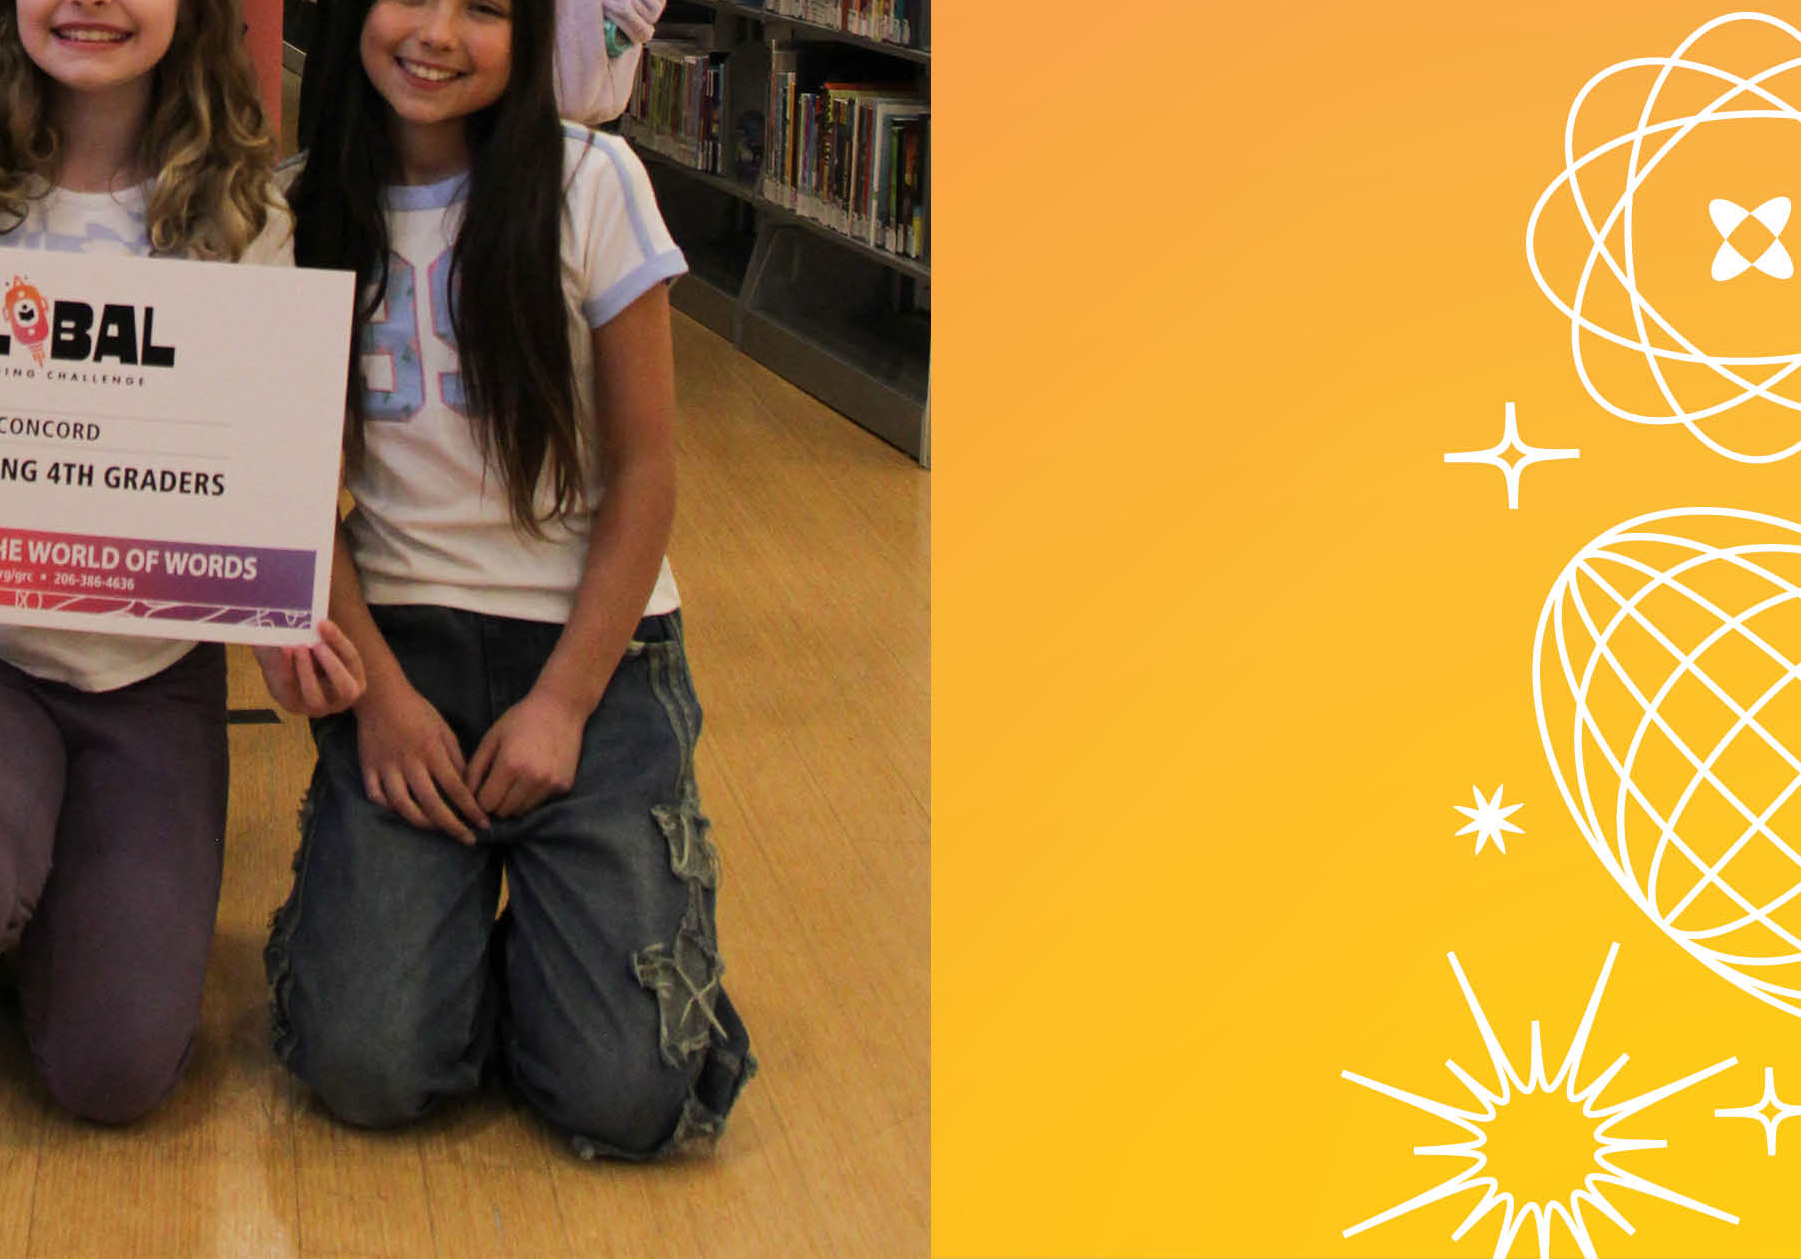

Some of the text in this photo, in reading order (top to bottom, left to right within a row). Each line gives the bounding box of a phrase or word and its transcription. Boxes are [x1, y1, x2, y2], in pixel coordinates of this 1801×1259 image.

[47, 371, 145, 387] CHALLENGE
[47, 462, 94, 487] 4TH
[104, 466, 226, 496] GRADERS
[28, 541, 120, 570] WORLD
[125, 548, 160, 573] OF
[164, 550, 258, 580] WORDS
[55, 572, 135, 591] 206-386-4636
